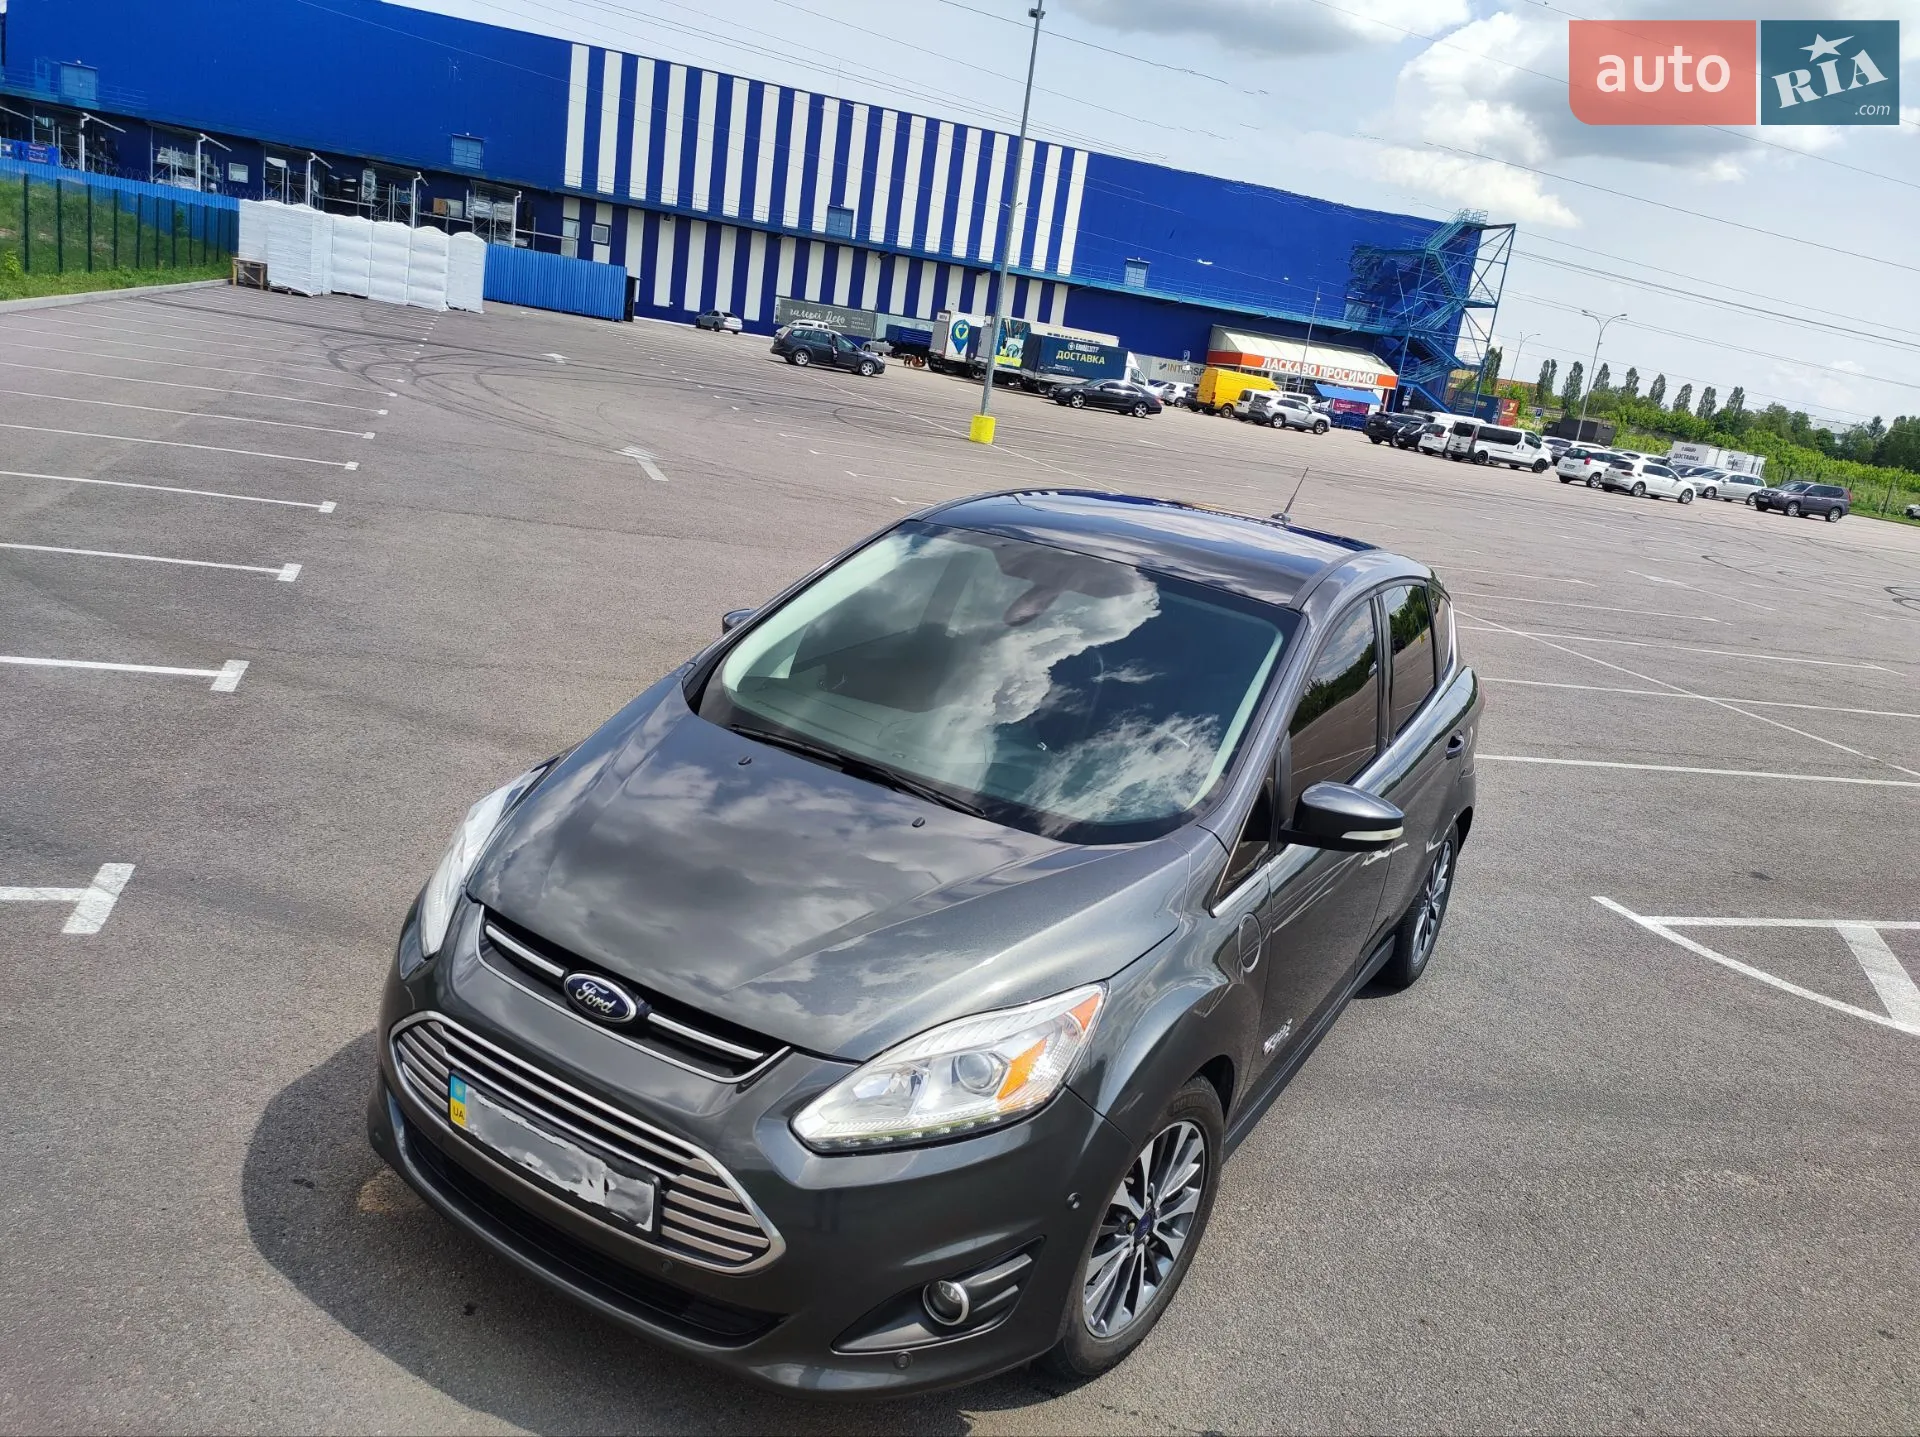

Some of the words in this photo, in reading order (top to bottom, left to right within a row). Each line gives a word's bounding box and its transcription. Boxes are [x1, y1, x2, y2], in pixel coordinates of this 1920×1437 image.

[1056, 350, 1105, 365] ДОСТАВКА
[1261, 357, 1317, 375] ЛАСКАВО
[1318, 366, 1378, 385] ПРОСИМО!
[576, 981, 616, 1013] Ford
[453, 1105, 465, 1121] UA
